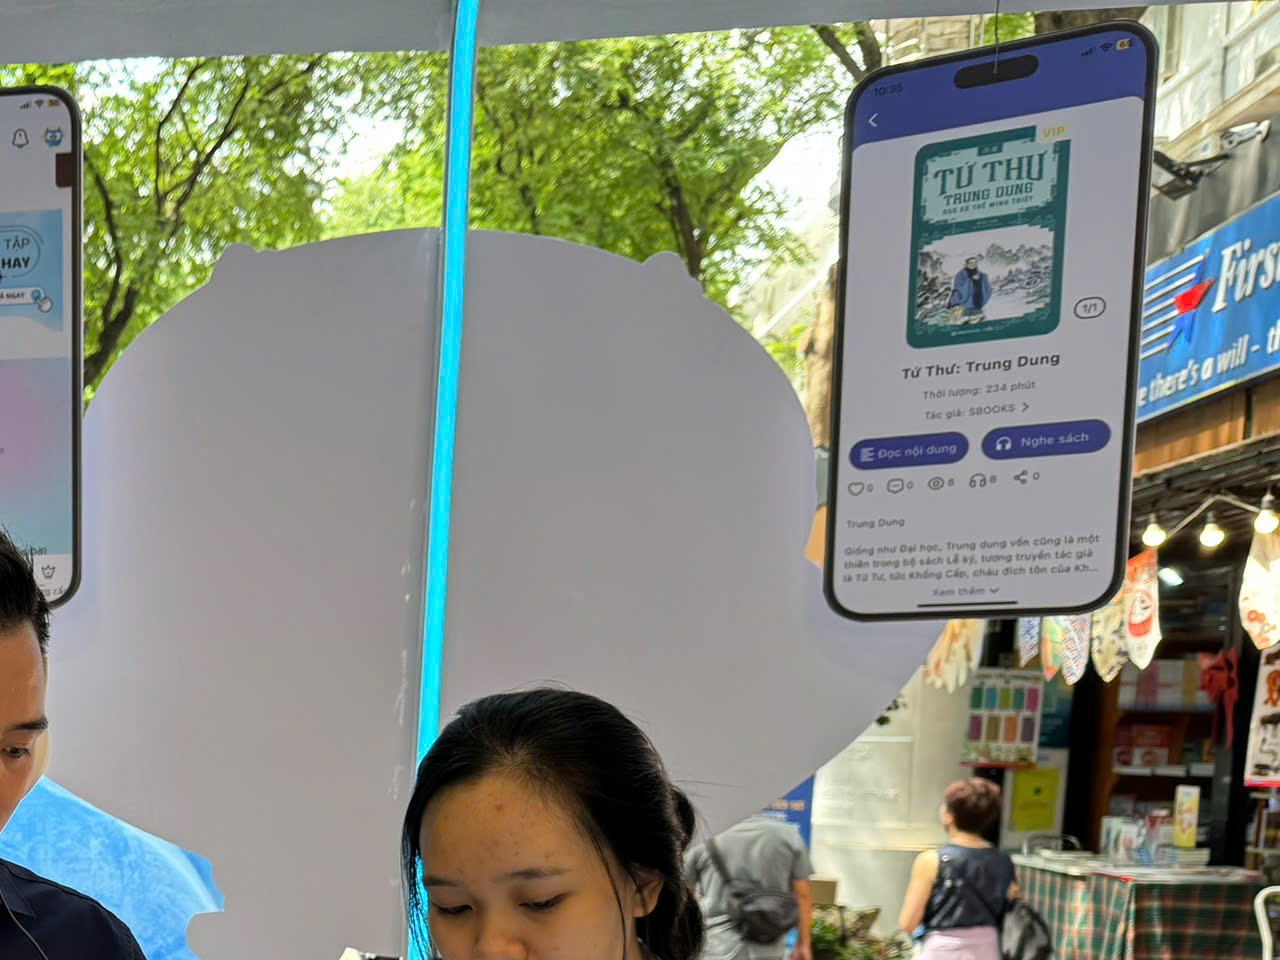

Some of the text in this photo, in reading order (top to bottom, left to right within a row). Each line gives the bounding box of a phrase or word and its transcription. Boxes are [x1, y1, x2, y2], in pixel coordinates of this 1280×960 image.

[1042, 125, 1065, 139] VIP
[933, 150, 1047, 196] TỨ THƯ
[943, 182, 1033, 206] TRUNG DUNG
[4, 236, 30, 252] TẬP
[2, 256, 31, 269] HAY
[1082, 302, 1098, 314] 1/1
[902, 354, 1061, 379] Tứ Thư: Trung Dung
[1149, 359, 1200, 402] there's
[1201, 357, 1215, 382] a
[1217, 334, 1250, 374] will
[923, 389, 946, 400] Thời
[986, 383, 1008, 394] 234
[1010, 381, 1036, 393] phút
[924, 403, 1016, 420] Tác giả: SBOOKS
[1021, 432, 1090, 449] Nghe sách
[878, 443, 958, 460] Đọc nội dung
[1032, 471, 1041, 481] 0
[847, 518, 905, 530] Trung Dung
[946, 541, 977, 551] Trung
[979, 540, 1007, 549] dung
[1032, 537, 1061, 546] cũng
[1064, 535, 1075, 544] là
[1077, 533, 1100, 544] một
[872, 559, 900, 569] trong
[919, 556, 944, 566] sách
[1075, 548, 1093, 560] giả
[972, 567, 999, 577] cháu
[1028, 566, 1048, 575] tôn
[1050, 563, 1071, 574] của
[932, 586, 985, 596] Xem thêm
